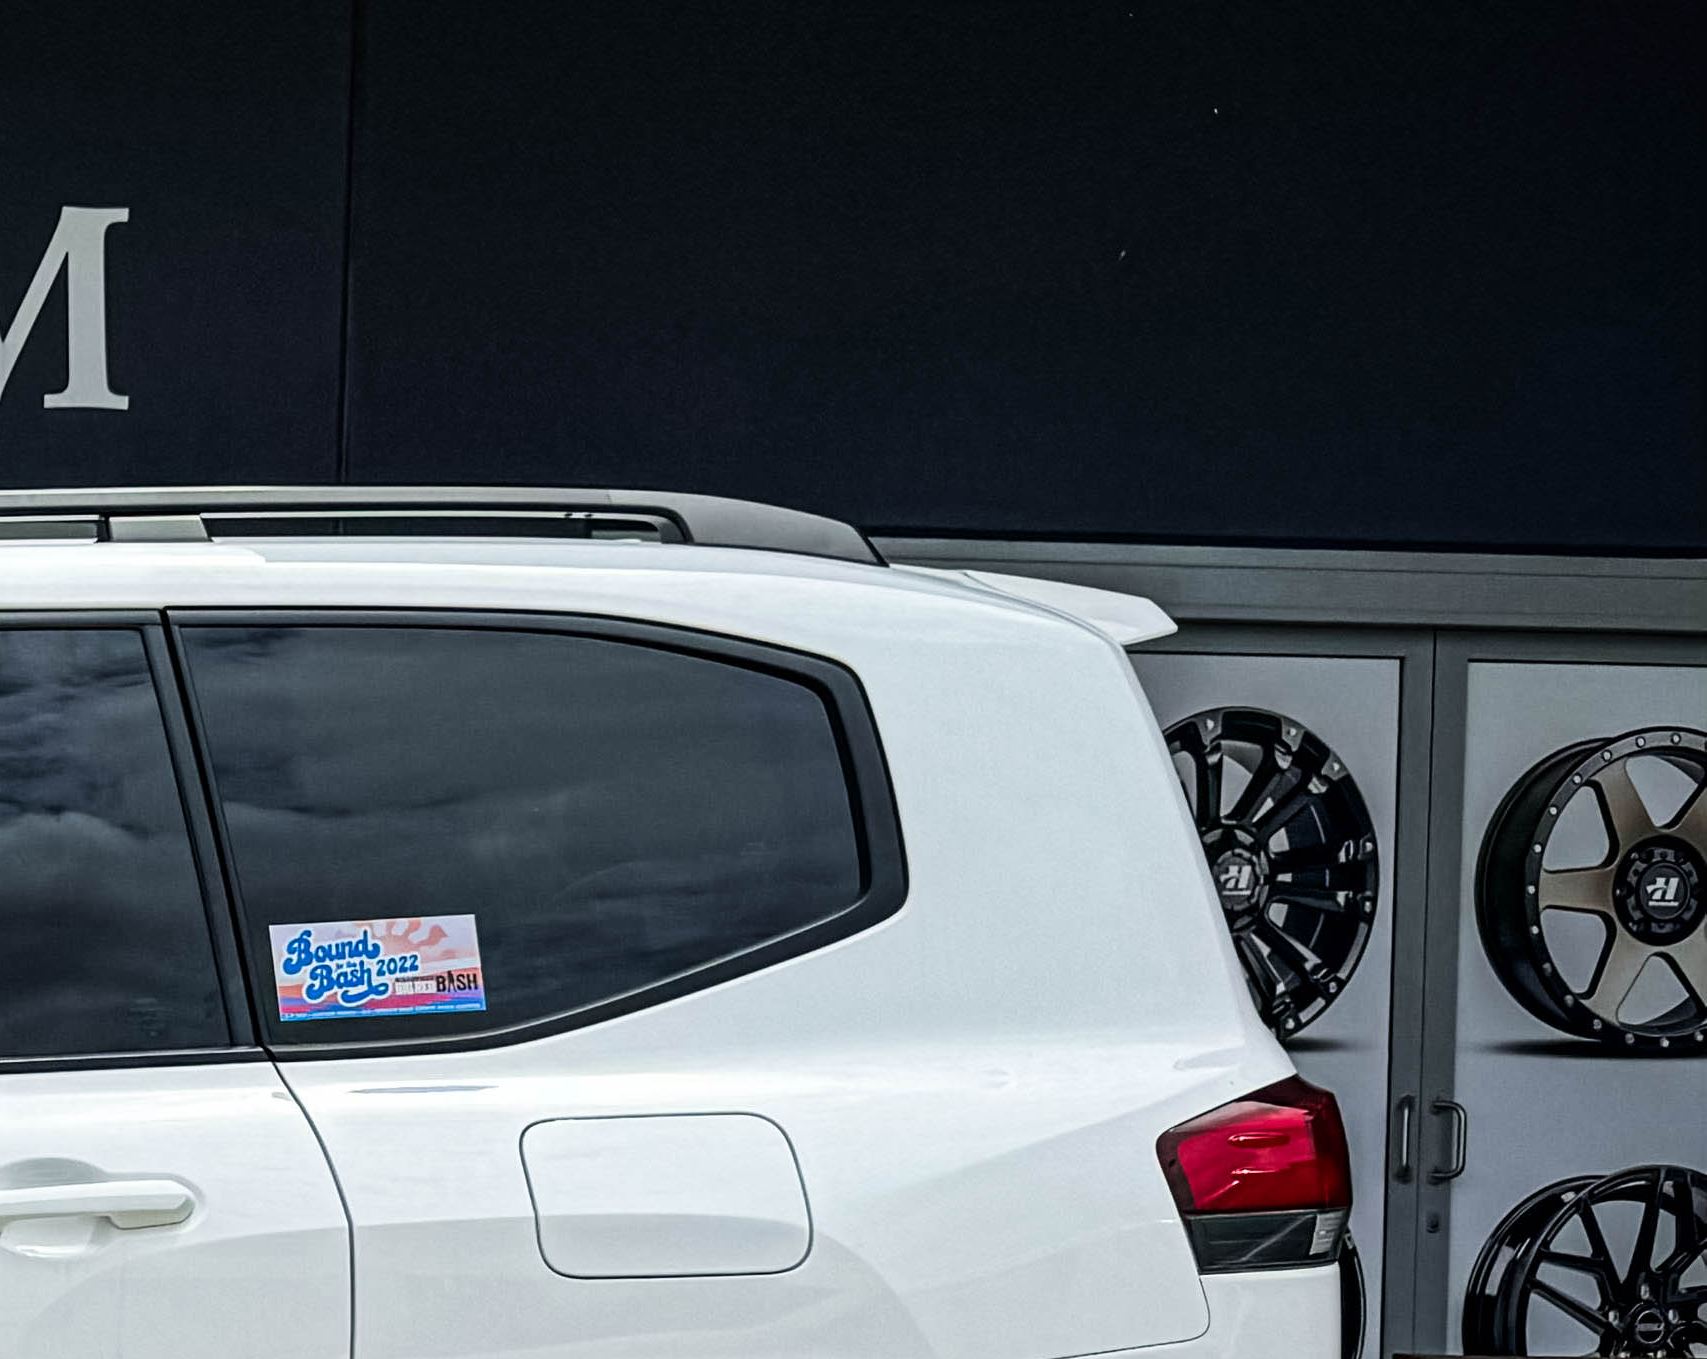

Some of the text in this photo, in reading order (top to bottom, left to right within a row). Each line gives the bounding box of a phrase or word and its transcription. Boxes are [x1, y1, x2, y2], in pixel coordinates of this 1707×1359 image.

[283, 930, 380, 975] Bound
[306, 954, 419, 1004] Bash 2022
[436, 971, 478, 993] BASH
